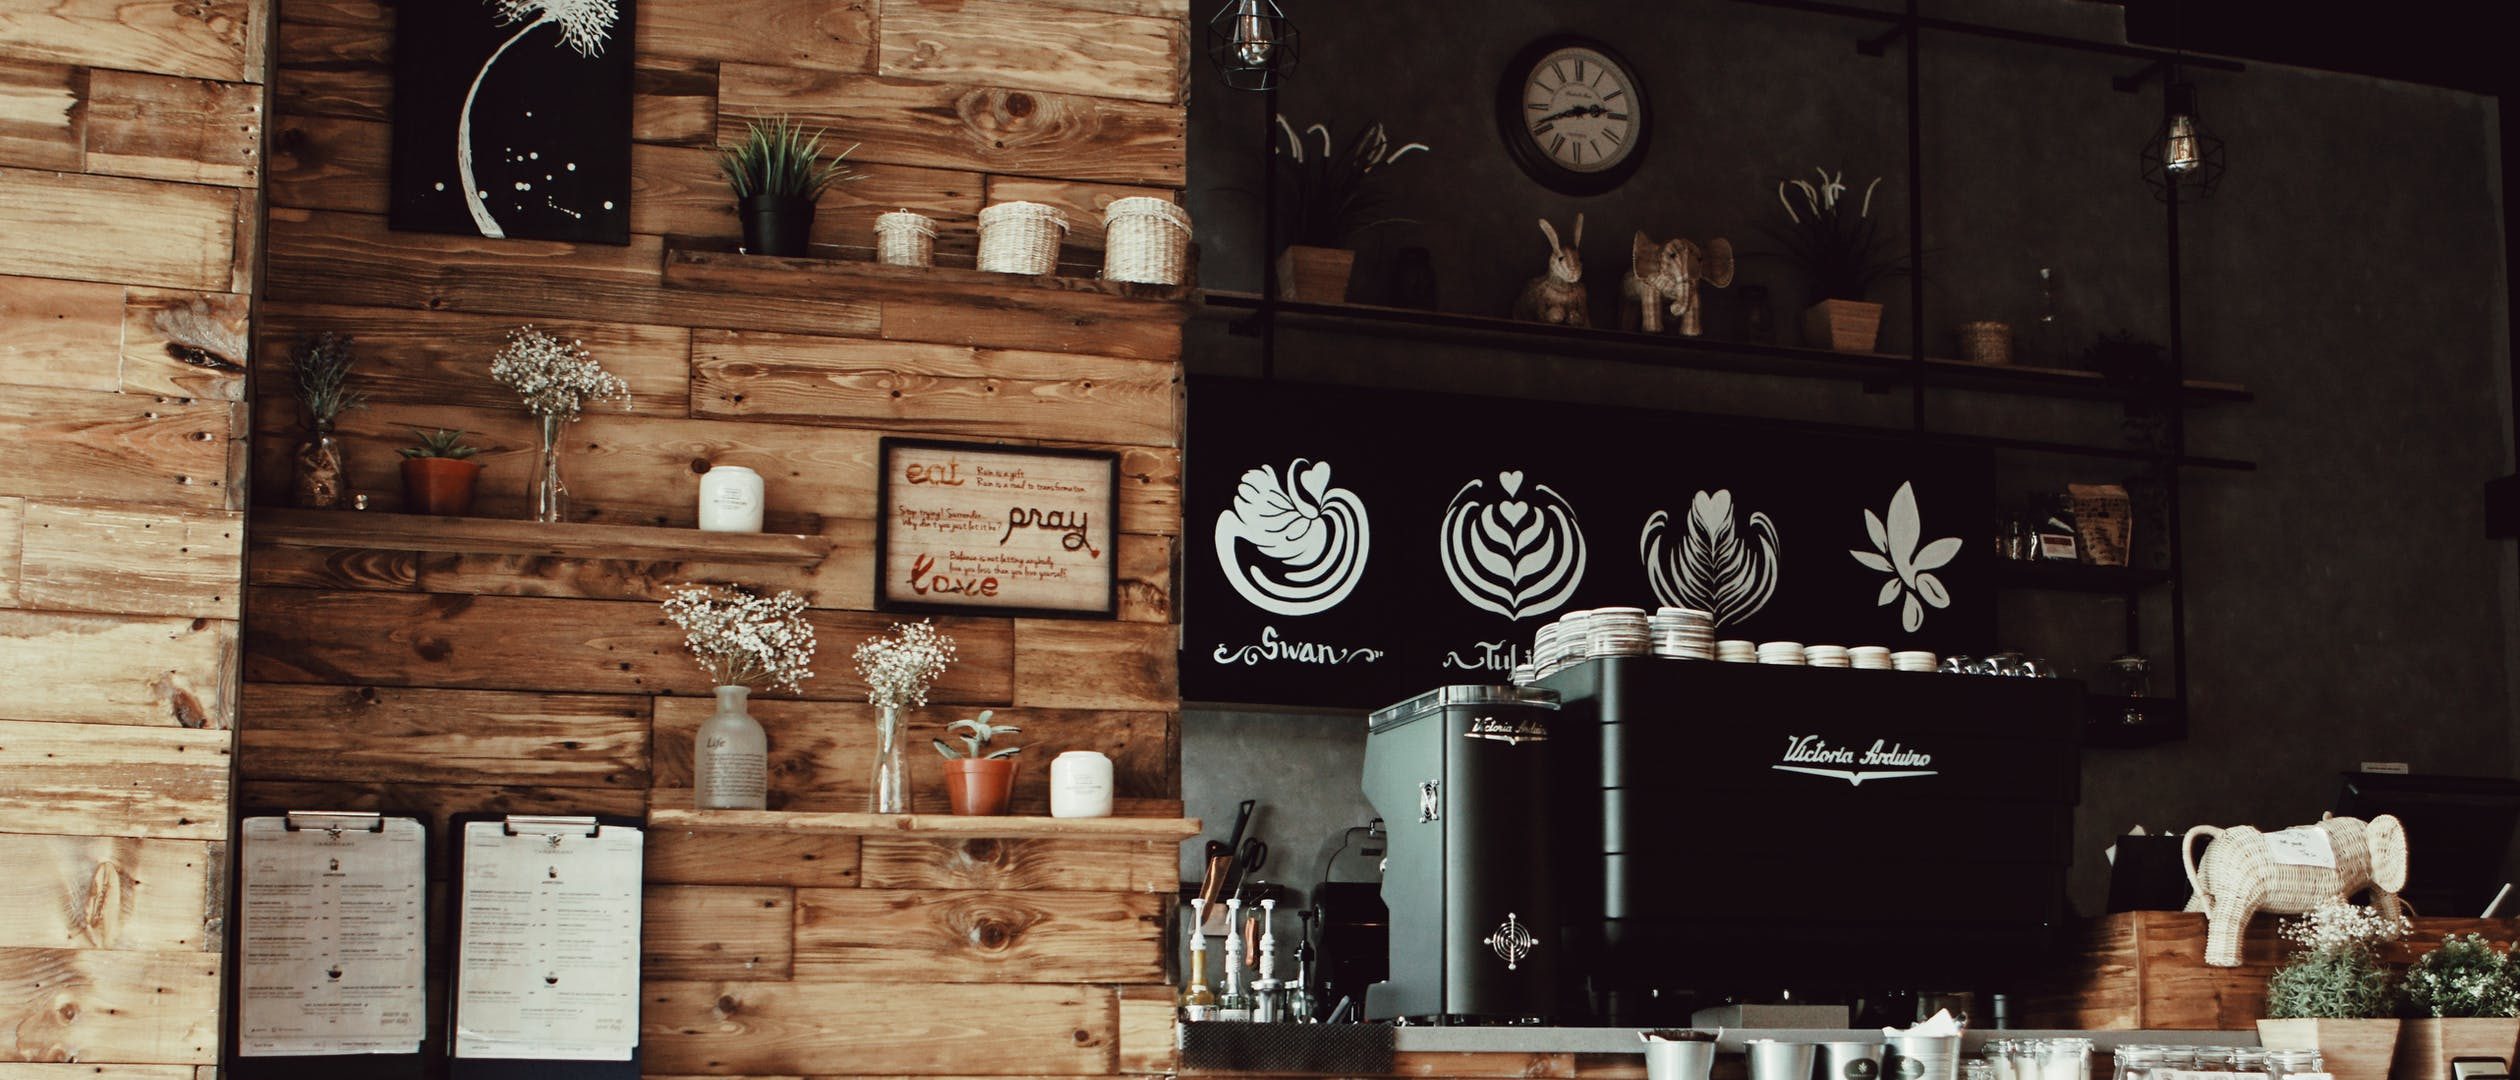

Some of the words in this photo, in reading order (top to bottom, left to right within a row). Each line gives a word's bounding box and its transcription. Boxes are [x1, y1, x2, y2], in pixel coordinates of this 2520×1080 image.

[905, 458, 965, 486] eat
[1000, 507, 1090, 552] pray
[905, 553, 998, 598] love
[1262, 625, 1346, 665] Swan
[1473, 639, 1534, 682] Tuli
[706, 736, 727, 751] Life
[1782, 734, 1855, 764] Victoria
[1858, 738, 1932, 767] Arduino
